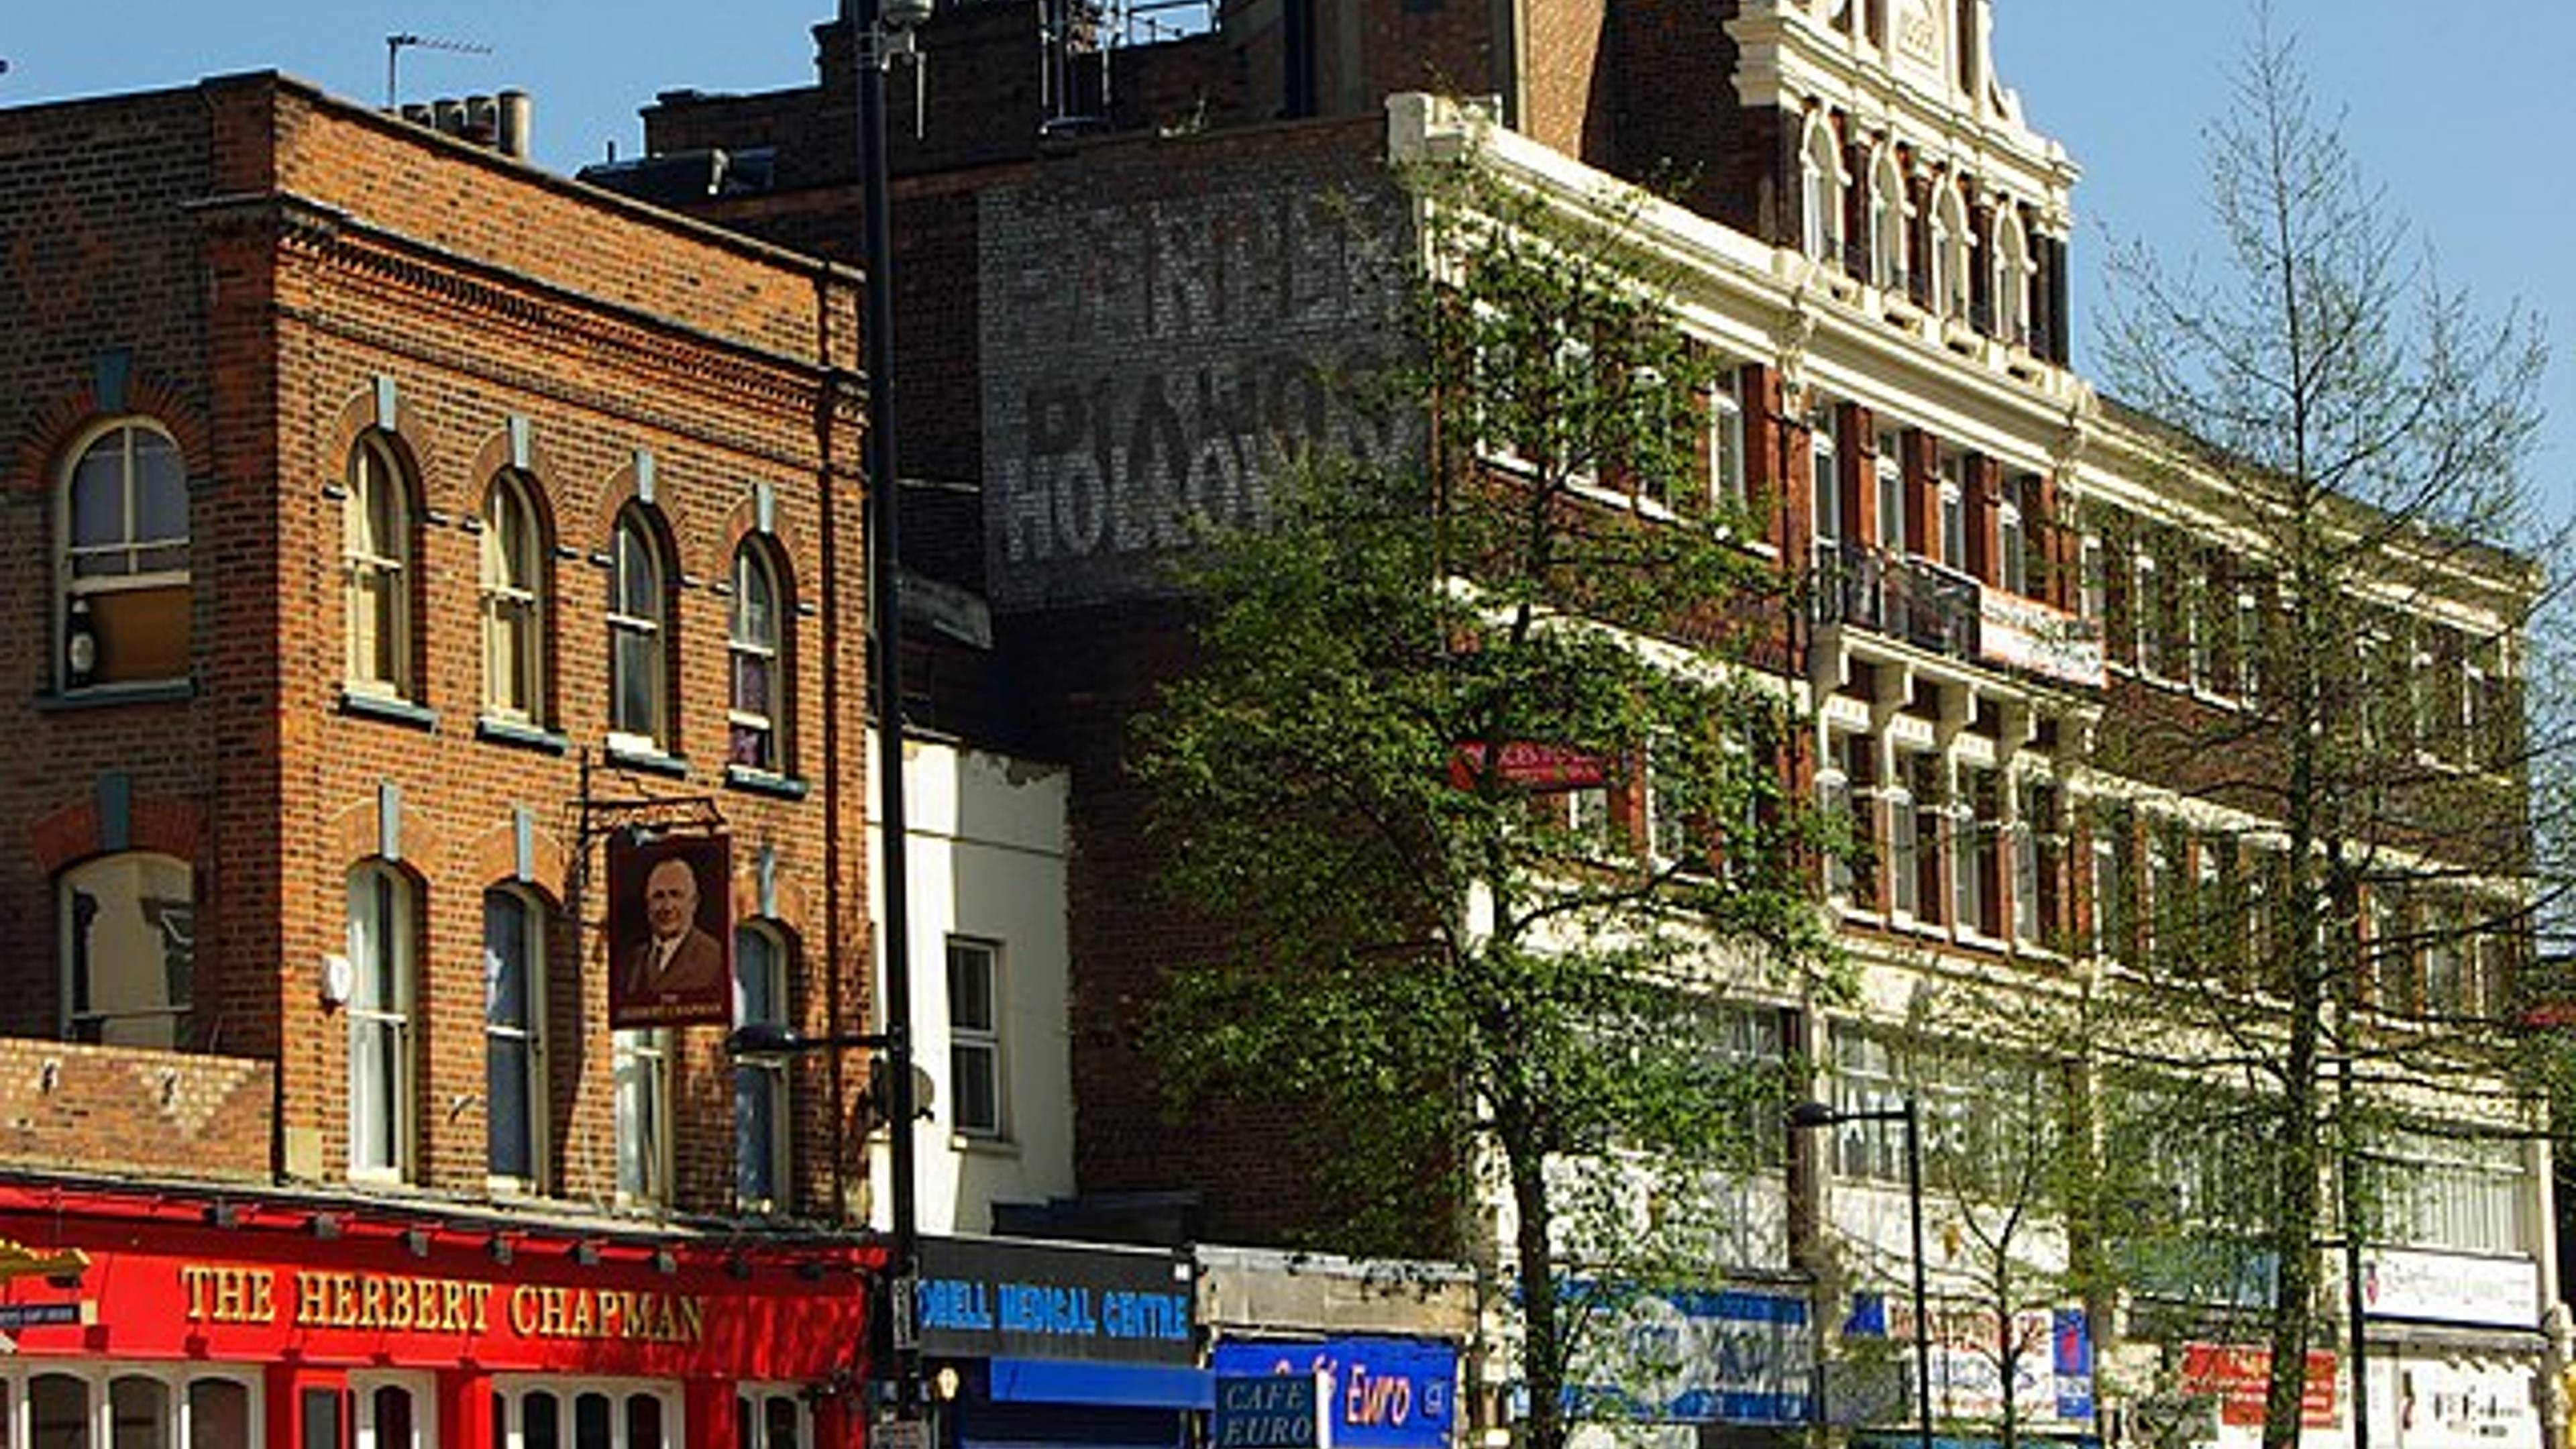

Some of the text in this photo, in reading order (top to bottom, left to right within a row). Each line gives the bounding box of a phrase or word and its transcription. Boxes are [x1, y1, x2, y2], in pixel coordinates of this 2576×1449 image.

[184, 1264, 703, 1342] THE HERBERT CHAPMAN
[998, 1282, 1097, 1336] MEDICAL
[1102, 1290, 1188, 1340] CENTRE
[1222, 1414, 1313, 1446] EURO
